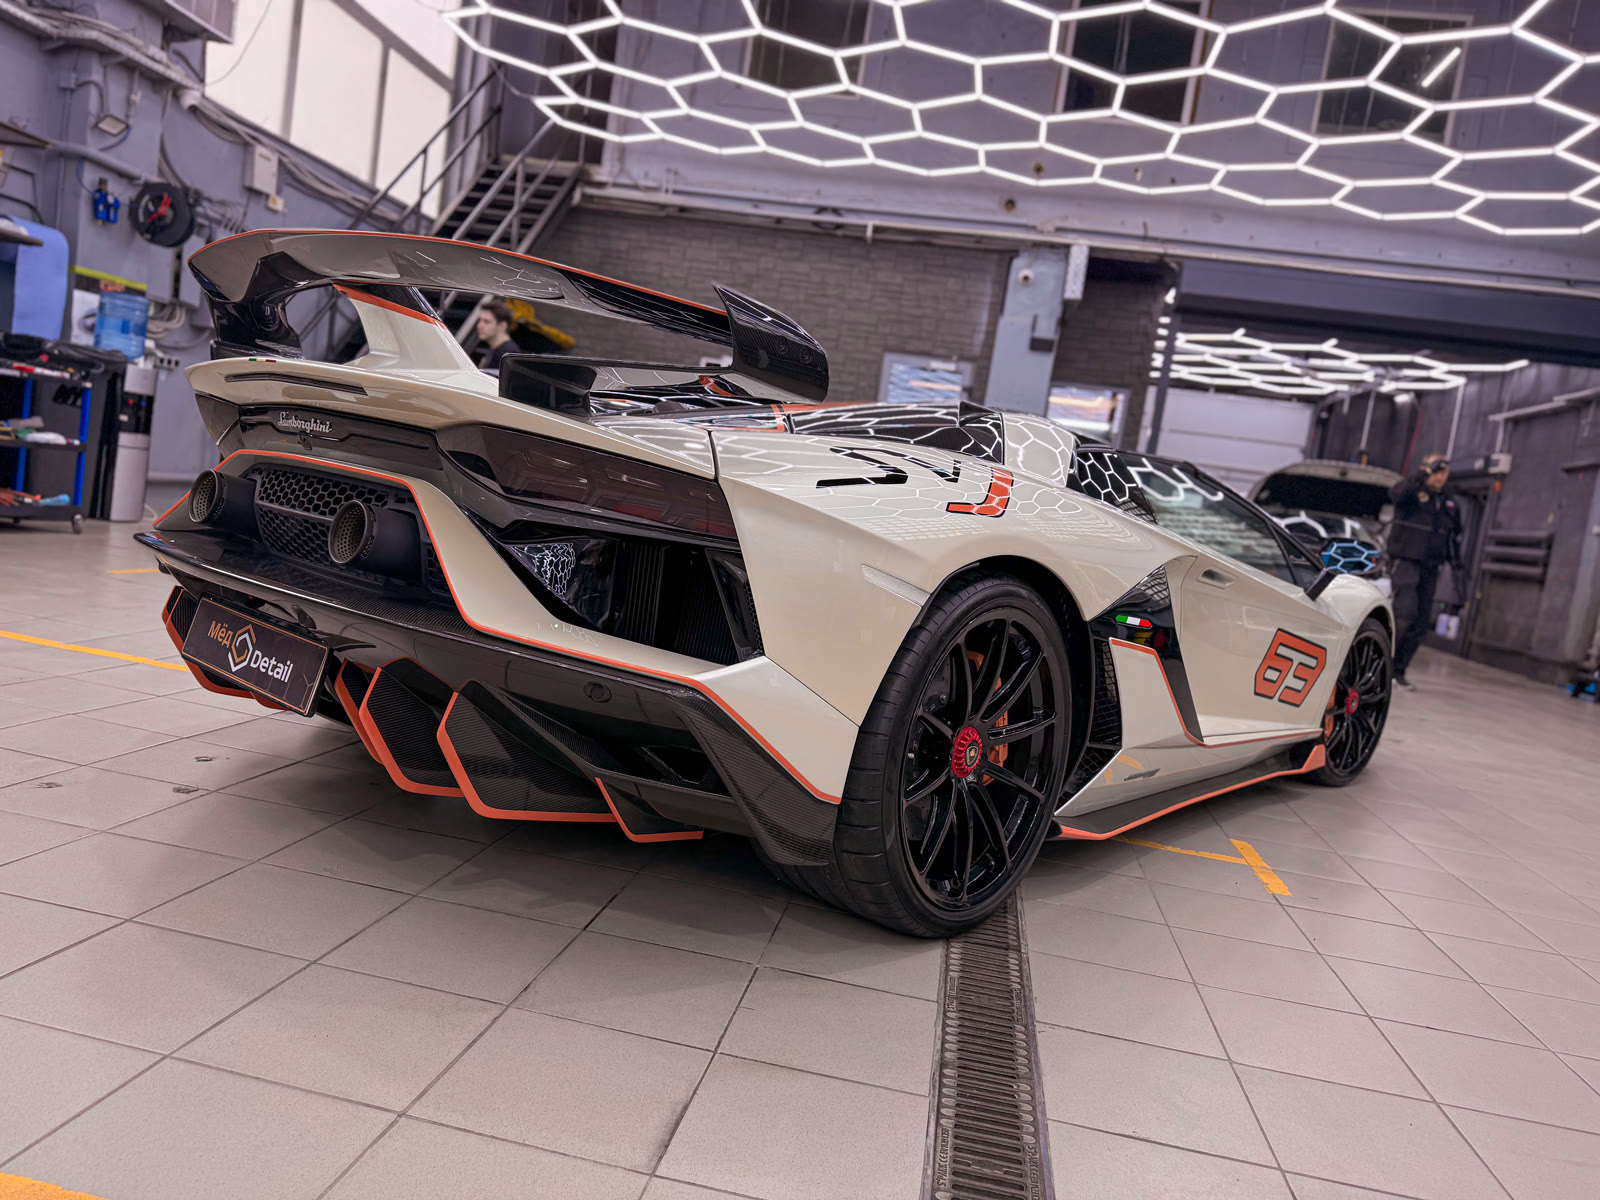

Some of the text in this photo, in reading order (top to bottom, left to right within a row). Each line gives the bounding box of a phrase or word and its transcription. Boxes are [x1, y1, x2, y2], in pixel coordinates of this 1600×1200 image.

[278, 411, 333, 433] Lamborghini
[250, 650, 294, 683] Detail
[1254, 627, 1327, 708] 63
